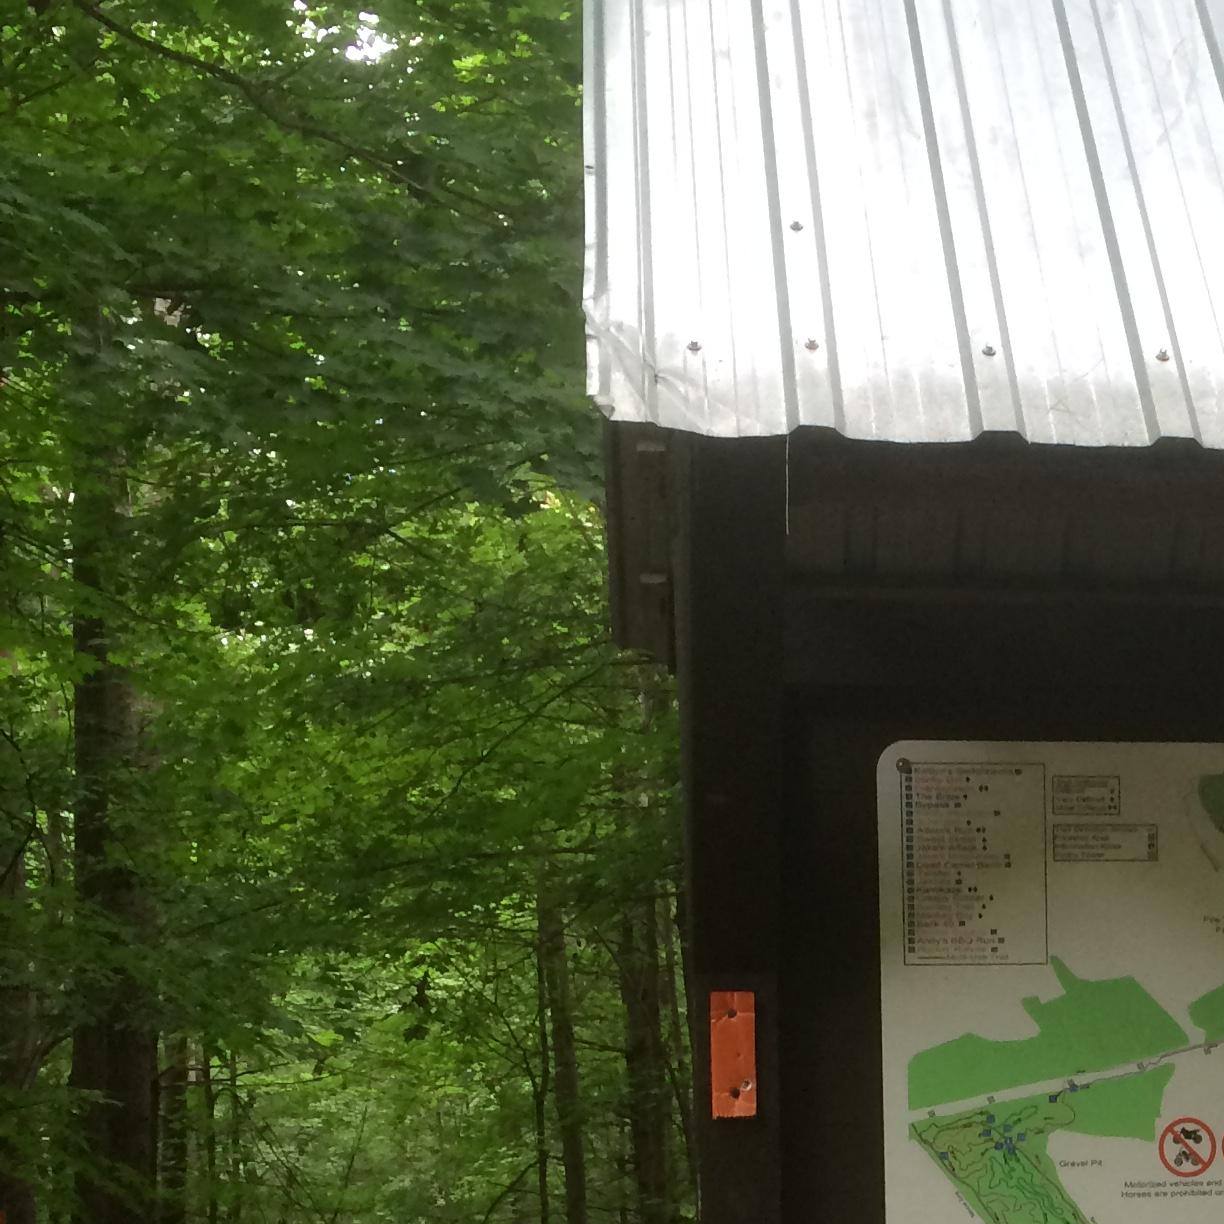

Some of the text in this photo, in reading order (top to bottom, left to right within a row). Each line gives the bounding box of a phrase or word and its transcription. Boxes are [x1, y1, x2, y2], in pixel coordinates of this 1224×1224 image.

[1124, 1180, 1167, 1188] Motorized
[1169, 1179, 1204, 1187] vehicles
[1170, 1189, 1212, 1197] prohibited
